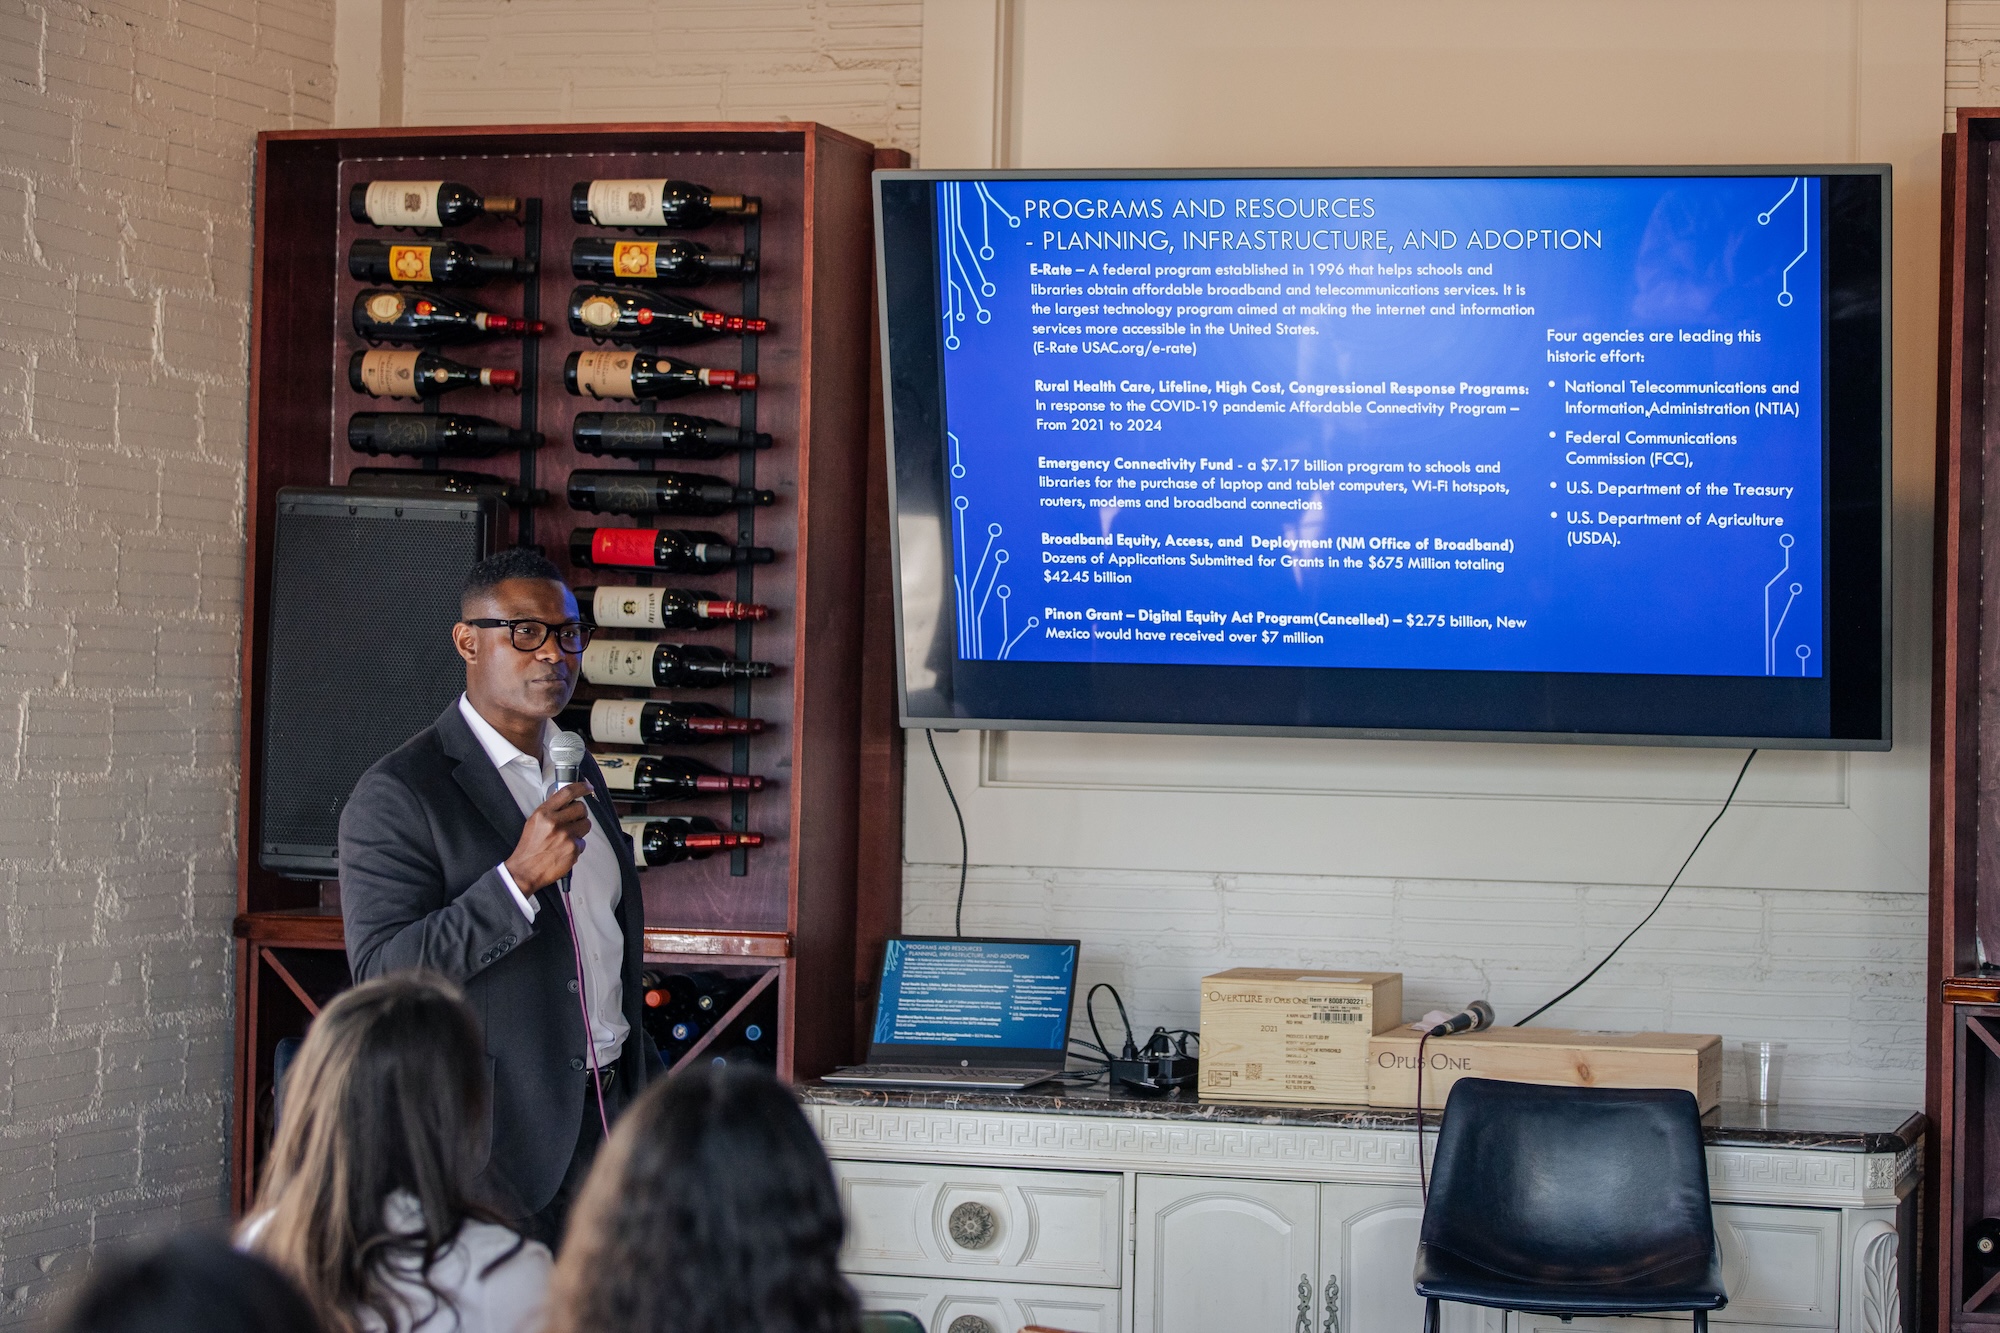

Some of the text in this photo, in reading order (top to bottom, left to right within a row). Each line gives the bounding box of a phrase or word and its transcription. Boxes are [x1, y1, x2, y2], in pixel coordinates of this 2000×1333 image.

[1024, 198, 1374, 219] PROGRAMS AND RESOURCES
[1043, 229, 1601, 254] PLANNING, INFRASTRUCTURE, AND ADOPTION
[1029, 263, 1492, 278] E-Rate A federal program established in 1996 that helps schools and
[1547, 328, 1761, 345] Four agencies are leading this
[1033, 340, 1196, 357] (E-Rate USAC.org/e-rate)
[1547, 349, 1644, 362] historic effort:
[1034, 379, 1529, 397] Rural Health Care, Lifeline, High Cost, Congressional Response Programs:
[1565, 379, 1799, 394] National Telecommunications and
[1035, 398, 1506, 417] In response to the COVID-19 pandemic Affordable Connectivity Program
[1649, 400, 1751, 416] Administration
[1754, 401, 1799, 418] (NTIA)
[1036, 418, 1162, 431] From 2021 to 2024
[1565, 430, 1737, 444] Federal Communications
[1038, 456, 1500, 475] Emergency Connectivity Fund a $7.17 billion program to schools and
[1565, 451, 1693, 468] Commission (FCC),
[1566, 480, 1793, 499] U.S. Department of the Treasury
[1567, 510, 1783, 528] U.S. Department of Agriculture
[1041, 532, 1514, 553] Broadband Equity, Access, and Deployment (NM Office of Broadband)
[1567, 531, 1620, 547] (USDA).
[1043, 568, 1132, 583] $42.45 billion
[1044, 607, 1526, 630] Pinon Grant Digital Equity Act Program(Cancelled) $2.75 billion, New
[1045, 625, 1323, 644] Mexico would have received over $7 million
[1328, 997, 1364, 1005] 8008730221
[1260, 1024, 1278, 1033] 2021
